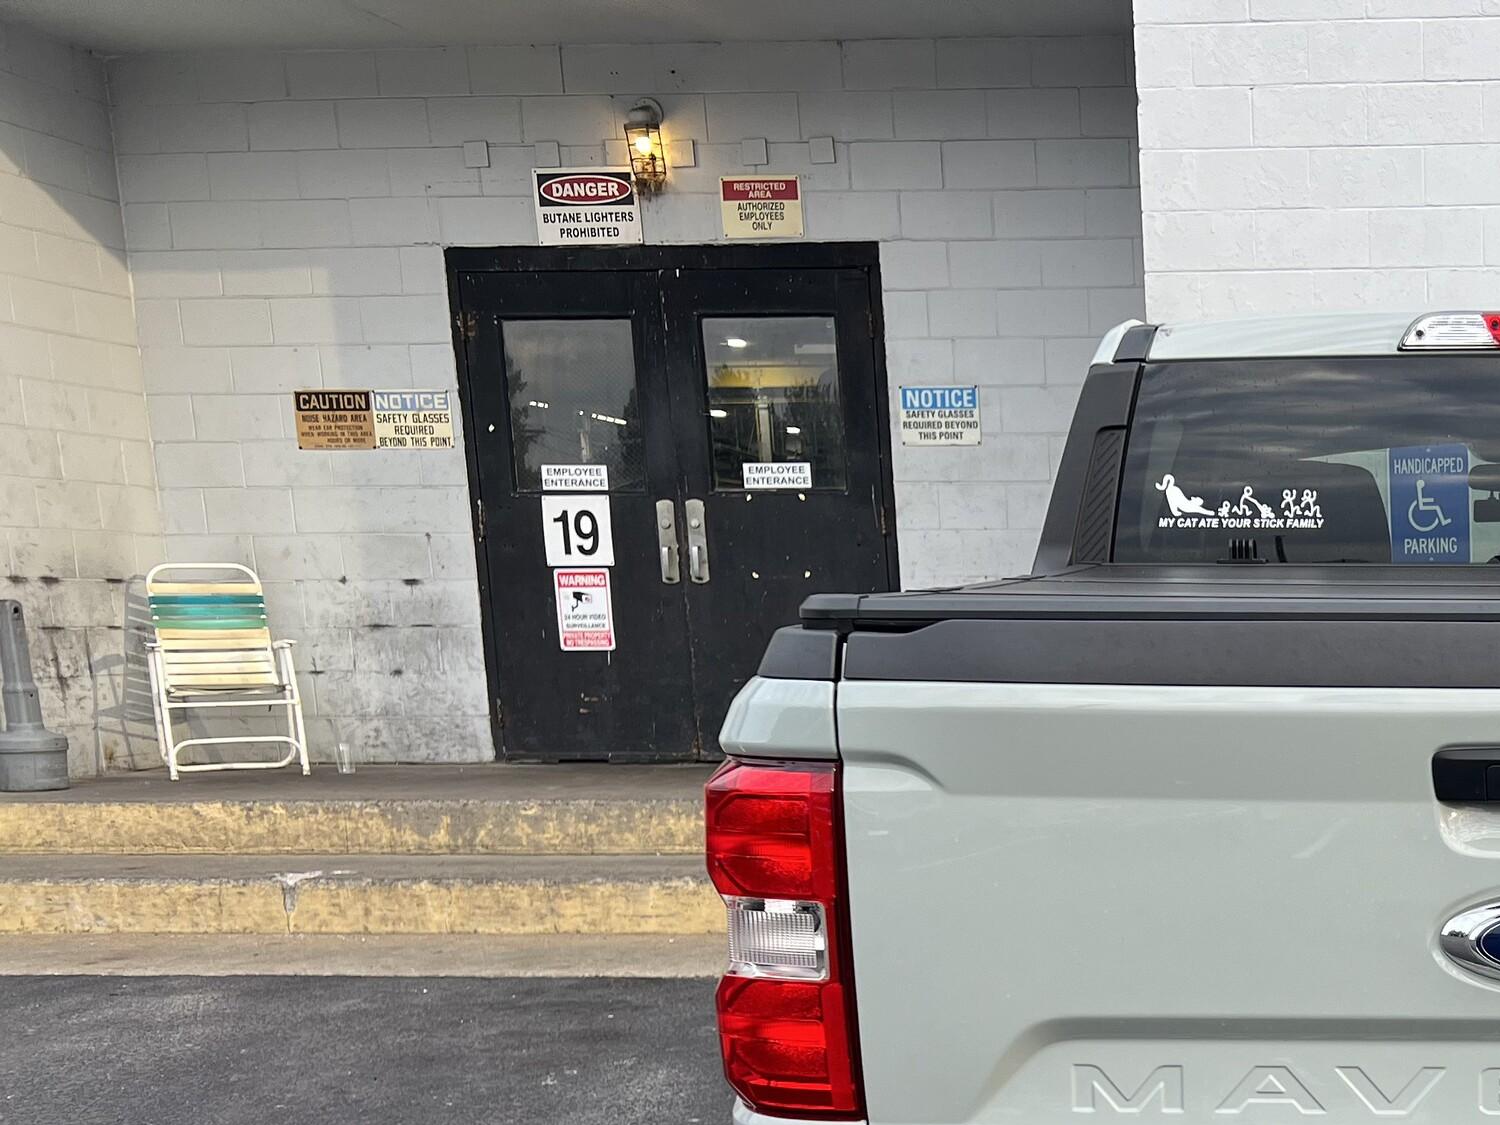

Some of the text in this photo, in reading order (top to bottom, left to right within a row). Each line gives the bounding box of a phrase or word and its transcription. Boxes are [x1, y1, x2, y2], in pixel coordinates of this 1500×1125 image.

[552, 181, 619, 197] DANGER
[733, 182, 786, 192] RESTRICTED
[748, 190, 772, 199] AREA
[737, 201, 785, 211] AUTHORIZED
[543, 211, 634, 223] BUTANE LIGHTERS
[739, 211, 785, 221] EMPLOYEES
[752, 221, 773, 231] ONLY
[559, 226, 620, 239] PROHIBITED
[300, 393, 366, 410] CAUTION
[376, 393, 448, 410] NOTICE
[906, 390, 973, 408] NOTICE
[322, 414, 348, 422] HAZARD
[350, 414, 367, 422] AREA
[376, 413, 450, 423] SAFETY GLASSES
[938, 410, 974, 418] GLASSES
[394, 425, 435, 435] REQUIRED
[903, 421, 978, 429] REQUIRED BEYOND
[918, 431, 964, 440] THIS POINT
[379, 437, 451, 447] BEYOND THIS POINT
[748, 466, 805, 474] EMPLOYEE
[1394, 456, 1463, 474] HANDICAPPED
[547, 468, 602, 476] EMPLOYEE
[544, 479, 606, 487] ENTERANCE
[746, 477, 809, 485] ENTERANCE
[1158, 517, 1324, 529] MY CAT ATE YOUR STICK FAMILY
[553, 510, 600, 556] 19
[1404, 537, 1457, 554] PARKING
[559, 574, 606, 586] WARNING
